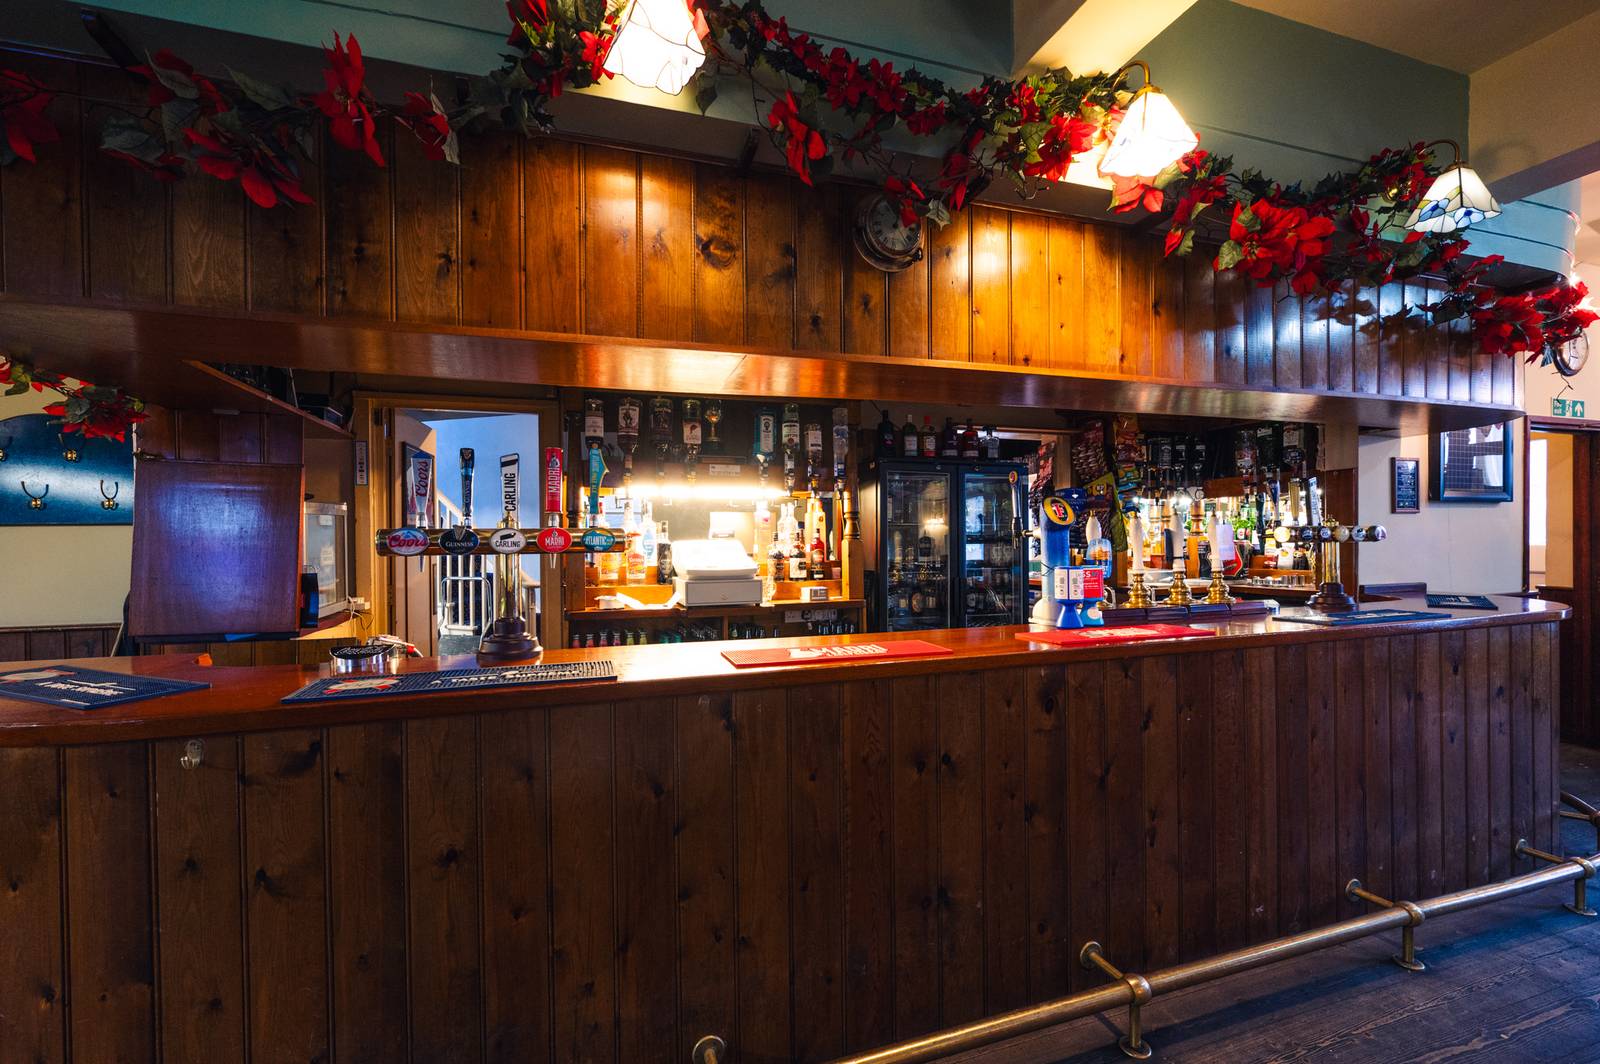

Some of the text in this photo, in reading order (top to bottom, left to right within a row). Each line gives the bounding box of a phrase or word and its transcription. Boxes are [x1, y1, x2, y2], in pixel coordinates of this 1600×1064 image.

[415, 461, 429, 497] Coors
[504, 473, 516, 511] CARLING
[386, 535, 428, 548] Coors
[495, 540, 521, 548] CARLING
